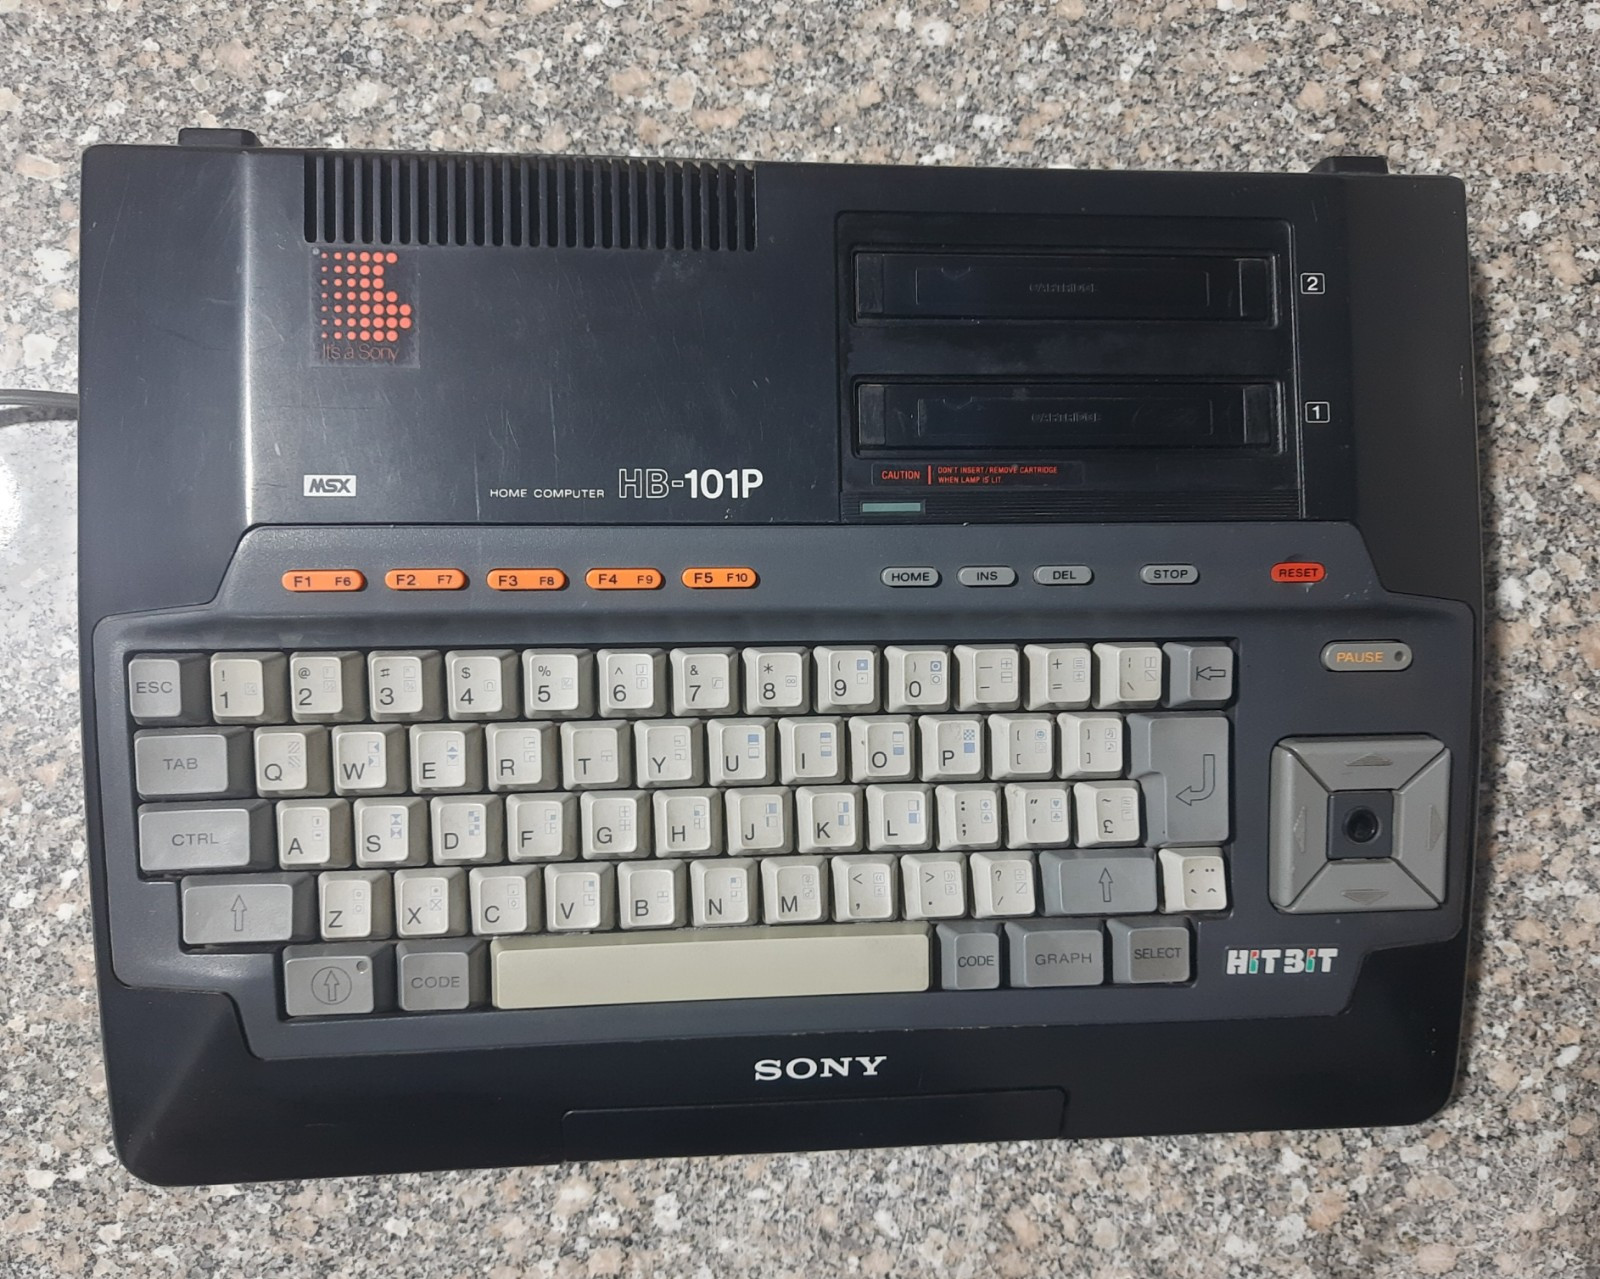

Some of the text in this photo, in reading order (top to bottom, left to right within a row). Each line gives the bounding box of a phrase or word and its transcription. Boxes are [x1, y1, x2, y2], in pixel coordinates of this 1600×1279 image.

[1306, 276, 1319, 291] 2
[322, 343, 399, 364] It's a Sony
[1312, 405, 1321, 420] 1
[881, 470, 921, 480] CAUTION
[937, 466, 958, 474] DON'T
[1020, 466, 1058, 474] CARTRIDGE
[308, 478, 352, 493] MSX
[490, 468, 764, 499] HOME COMPUTER HB-101P
[938, 476, 960, 484] WHEN
[961, 475, 981, 484] LAMP
[982, 475, 990, 484] IS
[396, 574, 453, 586] F2 F7
[598, 573, 654, 585] F4 F9
[694, 572, 748, 584] F5 F10
[891, 571, 930, 582] HOME
[976, 571, 998, 581] INS
[1052, 570, 1077, 580] DEL
[1153, 569, 1189, 579] STOP
[1278, 567, 1319, 578] RESET
[293, 575, 352, 588] F1 F6
[498, 575, 555, 587] F3 F8
[1052, 658, 1063, 670] +
[1336, 651, 1384, 664] PAUSE
[297, 667, 311, 680] @
[380, 668, 390, 678] #
[461, 666, 471, 680] $
[537, 665, 552, 677] %
[689, 664, 699, 676] &
[837, 660, 841, 672] (
[913, 661, 917, 673] )
[220, 670, 226, 682] !
[135, 681, 172, 694] ESC
[537, 684, 551, 703] 5
[612, 684, 627, 702] 6
[689, 684, 702, 702] 7
[762, 682, 776, 701] 8
[833, 678, 847, 697] 9
[908, 680, 922, 698] 0
[219, 691, 229, 709] 1
[298, 687, 313, 706] 2
[379, 687, 395, 706] 3
[459, 687, 474, 705] 4
[161, 757, 198, 771] TAB
[651, 756, 666, 774] Y
[725, 755, 739, 772] U
[801, 752, 806, 770] I
[871, 751, 888, 769] O
[942, 749, 955, 767] P
[1016, 753, 1022, 765] [
[1085, 752, 1092, 764] ]
[263, 763, 283, 782] Q
[342, 762, 365, 781] W
[422, 761, 437, 780] E
[500, 758, 515, 777] R
[577, 757, 592, 775] T
[960, 800, 966, 812] :
[671, 825, 686, 843] H
[744, 823, 755, 841] J
[816, 821, 831, 839] K
[886, 819, 899, 837] L
[961, 823, 967, 837] ;
[1102, 819, 1114, 834] £
[171, 833, 218, 847] CTRL
[443, 832, 459, 850] D
[521, 830, 534, 848] F
[596, 826, 613, 845] G
[287, 837, 303, 856] A
[365, 834, 382, 853] S
[852, 873, 863, 885] <
[925, 871, 935, 883] >
[994, 869, 1002, 882] ?
[634, 899, 649, 917] B
[708, 898, 723, 916] N
[780, 895, 798, 913] M
[997, 895, 1004, 907] /
[407, 907, 422, 925] X
[484, 905, 500, 924] C
[560, 902, 575, 920] V
[327, 910, 343, 929] Z
[1034, 952, 1092, 966] GRAPH
[1133, 947, 1182, 961] SELECT
[957, 955, 994, 969] CODE
[410, 976, 460, 990] CODE
[753, 1055, 888, 1081] SONY
